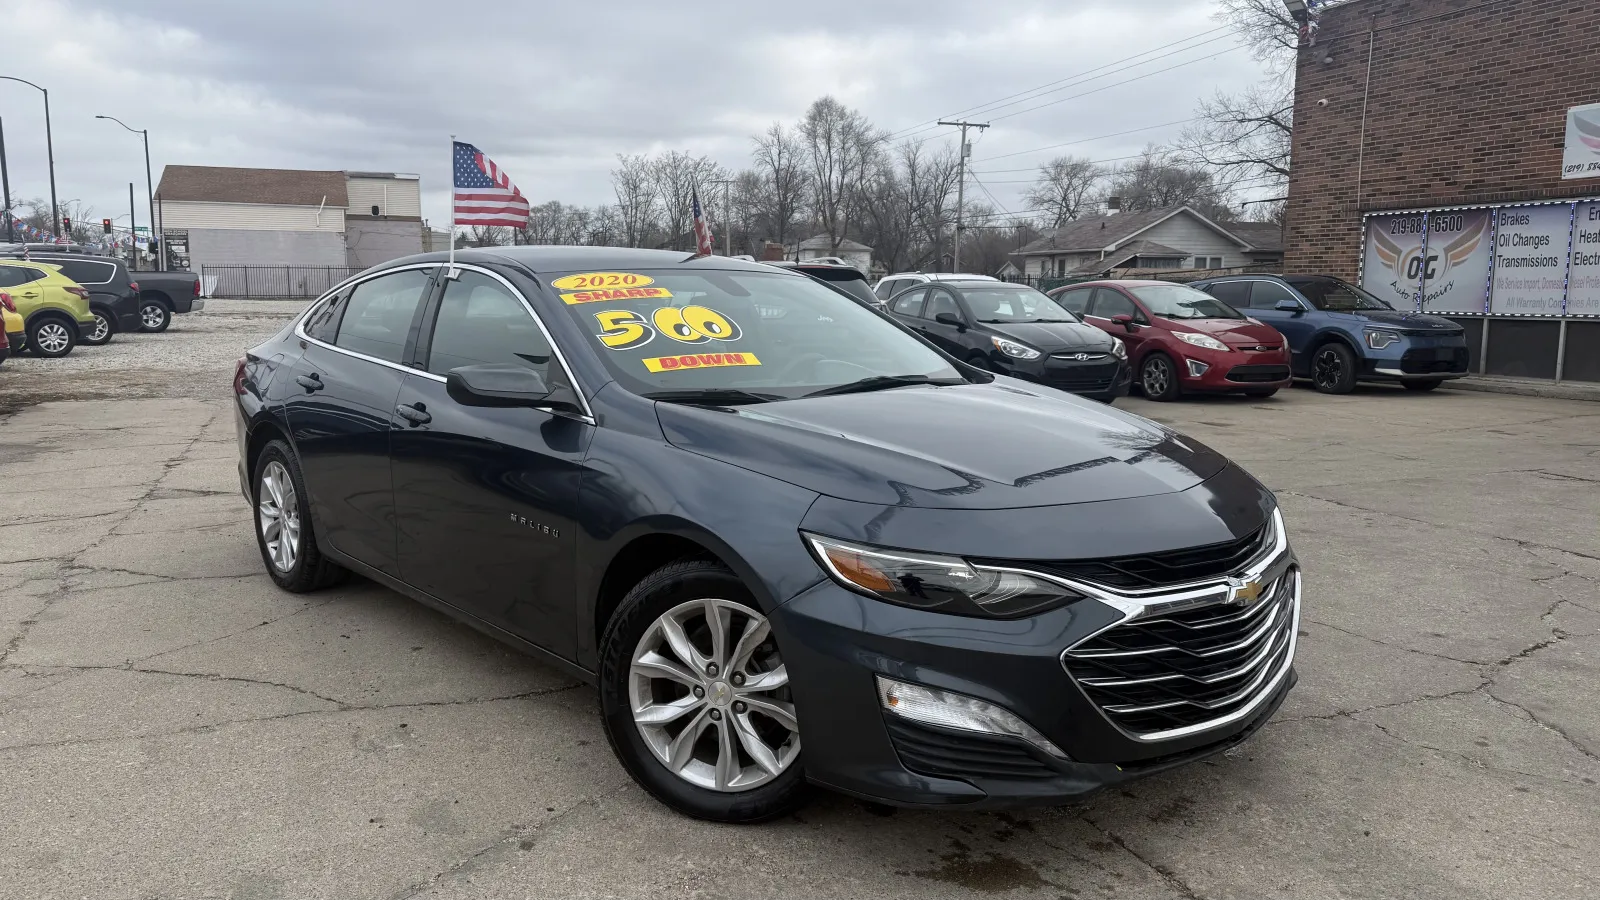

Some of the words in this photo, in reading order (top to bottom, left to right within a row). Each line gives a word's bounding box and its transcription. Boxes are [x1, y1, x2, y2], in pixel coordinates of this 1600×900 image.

[1565, 164, 1584, 172] (219)
[1500, 212, 1530, 226] Brakes
[1499, 233, 1510, 247] Oil
[1513, 233, 1550, 249] Changes
[1407, 254, 1439, 280] OG
[1497, 254, 1558, 268] Transmissions
[573, 275, 638, 288] 2020
[1505, 277, 1523, 289] Service
[1542, 277, 1566, 290] Domesti
[574, 288, 661, 302] SHARP
[1390, 280, 1410, 299] Auto
[1412, 279, 1455, 304] Repairs
[1506, 297, 1515, 308] All
[1516, 297, 1546, 310] Warranty
[1548, 297, 1584, 308] Comanies
[1586, 297, 1599, 308] Are
[593, 305, 743, 350] 500
[659, 353, 747, 369] DOWN
[510, 513, 560, 538] MALIBU
